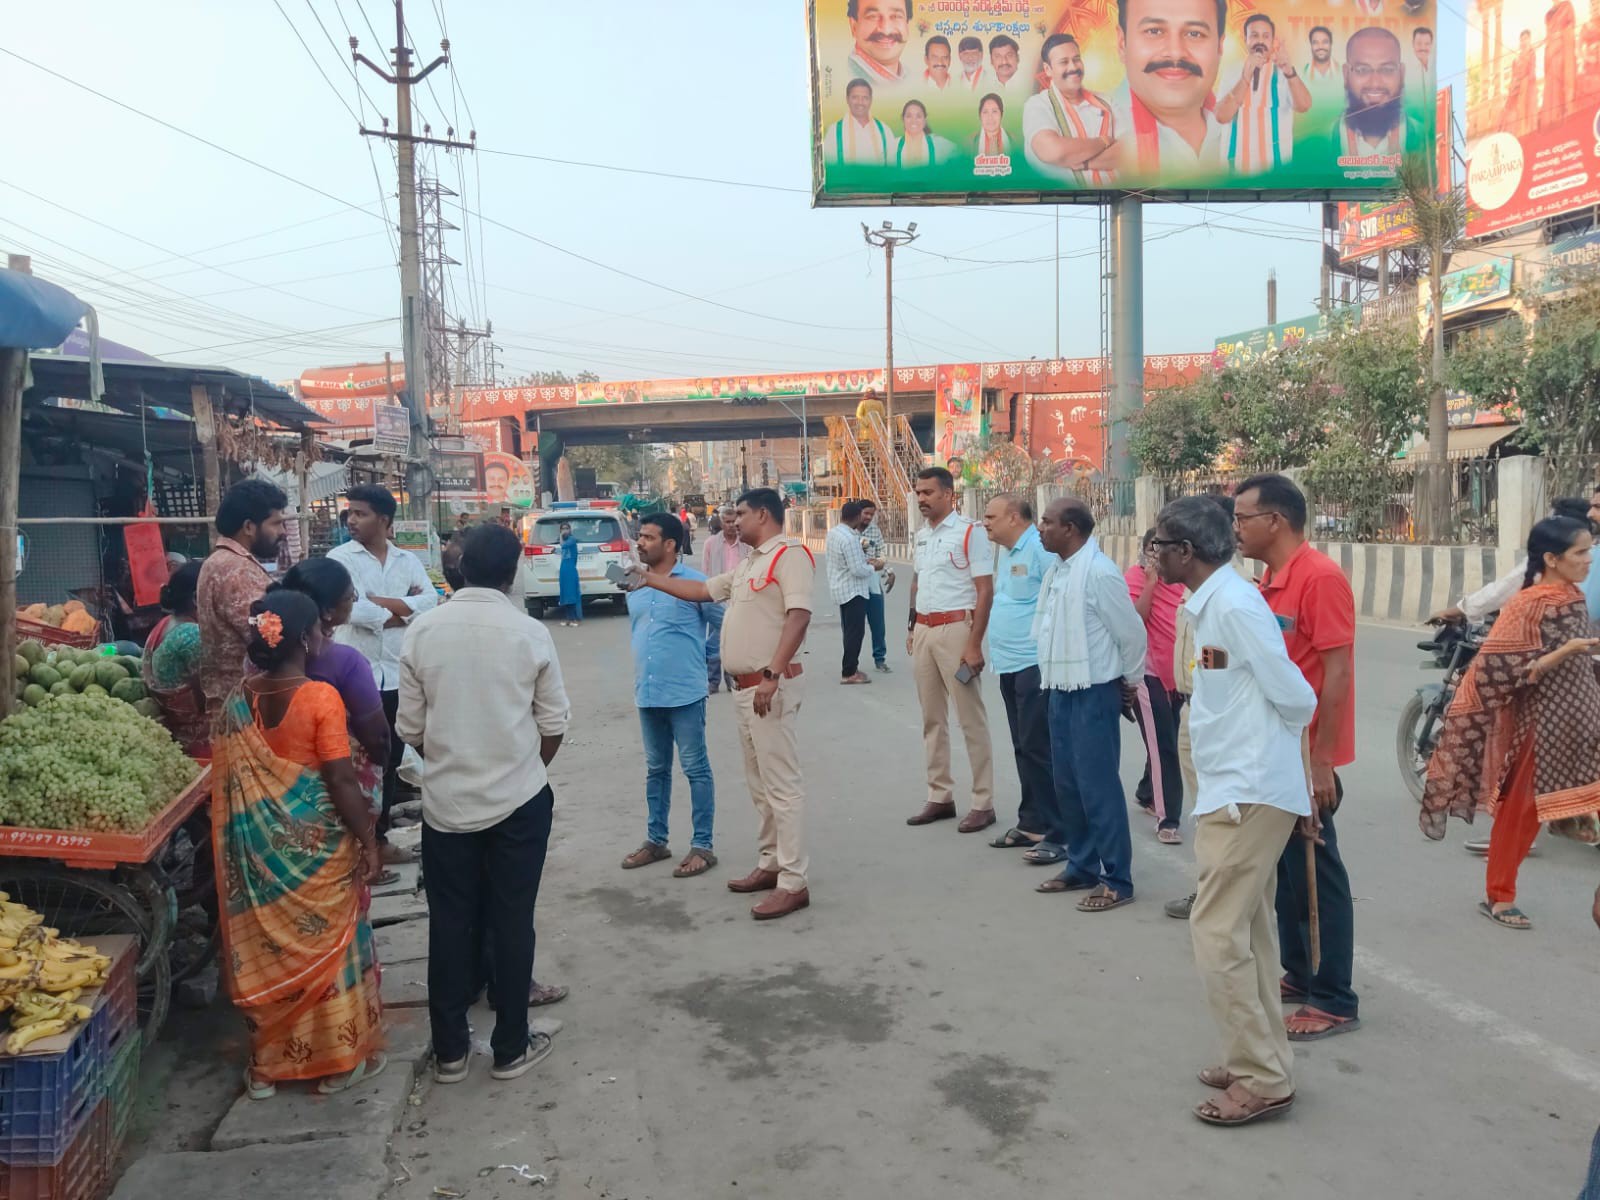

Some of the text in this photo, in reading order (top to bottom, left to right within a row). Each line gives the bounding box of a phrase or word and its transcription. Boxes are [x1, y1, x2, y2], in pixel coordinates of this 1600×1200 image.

[1360, 216, 1378, 241] SVR
[313, 376, 389, 389] MAHA CEMEN
